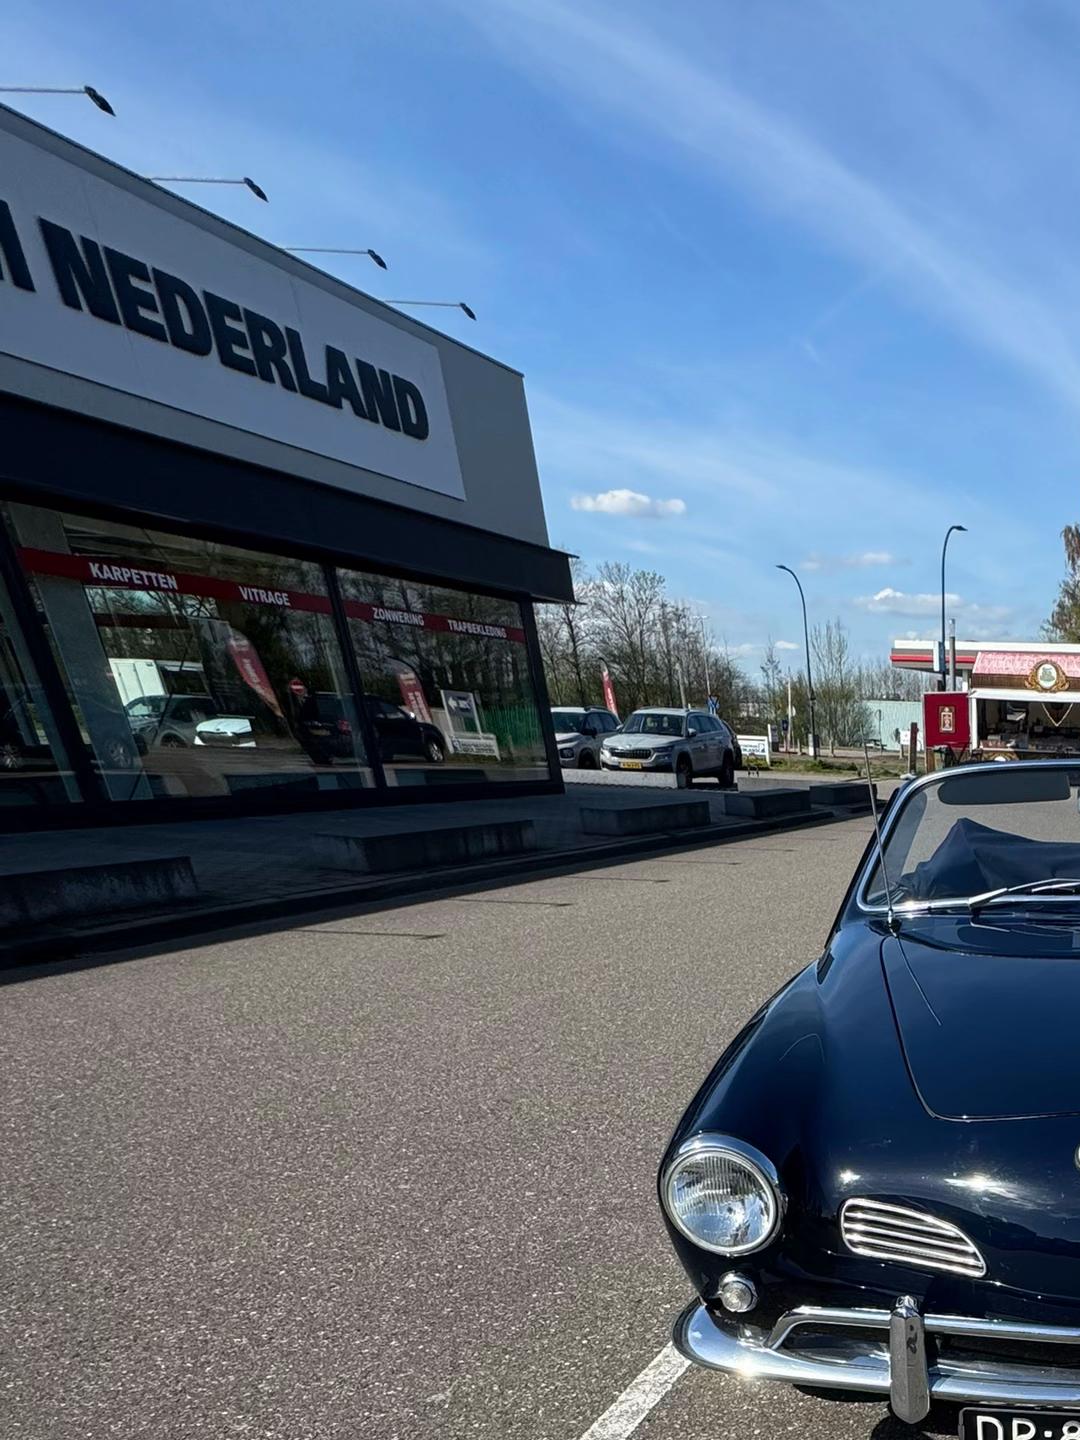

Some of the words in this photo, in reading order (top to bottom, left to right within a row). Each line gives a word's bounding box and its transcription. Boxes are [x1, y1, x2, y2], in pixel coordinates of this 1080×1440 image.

[38, 217, 430, 440] NEDERLAND
[88, 562, 178, 590] KARPETTEN
[238, 585, 291, 607] VITRAGE
[372, 607, 425, 627] ZONWERING
